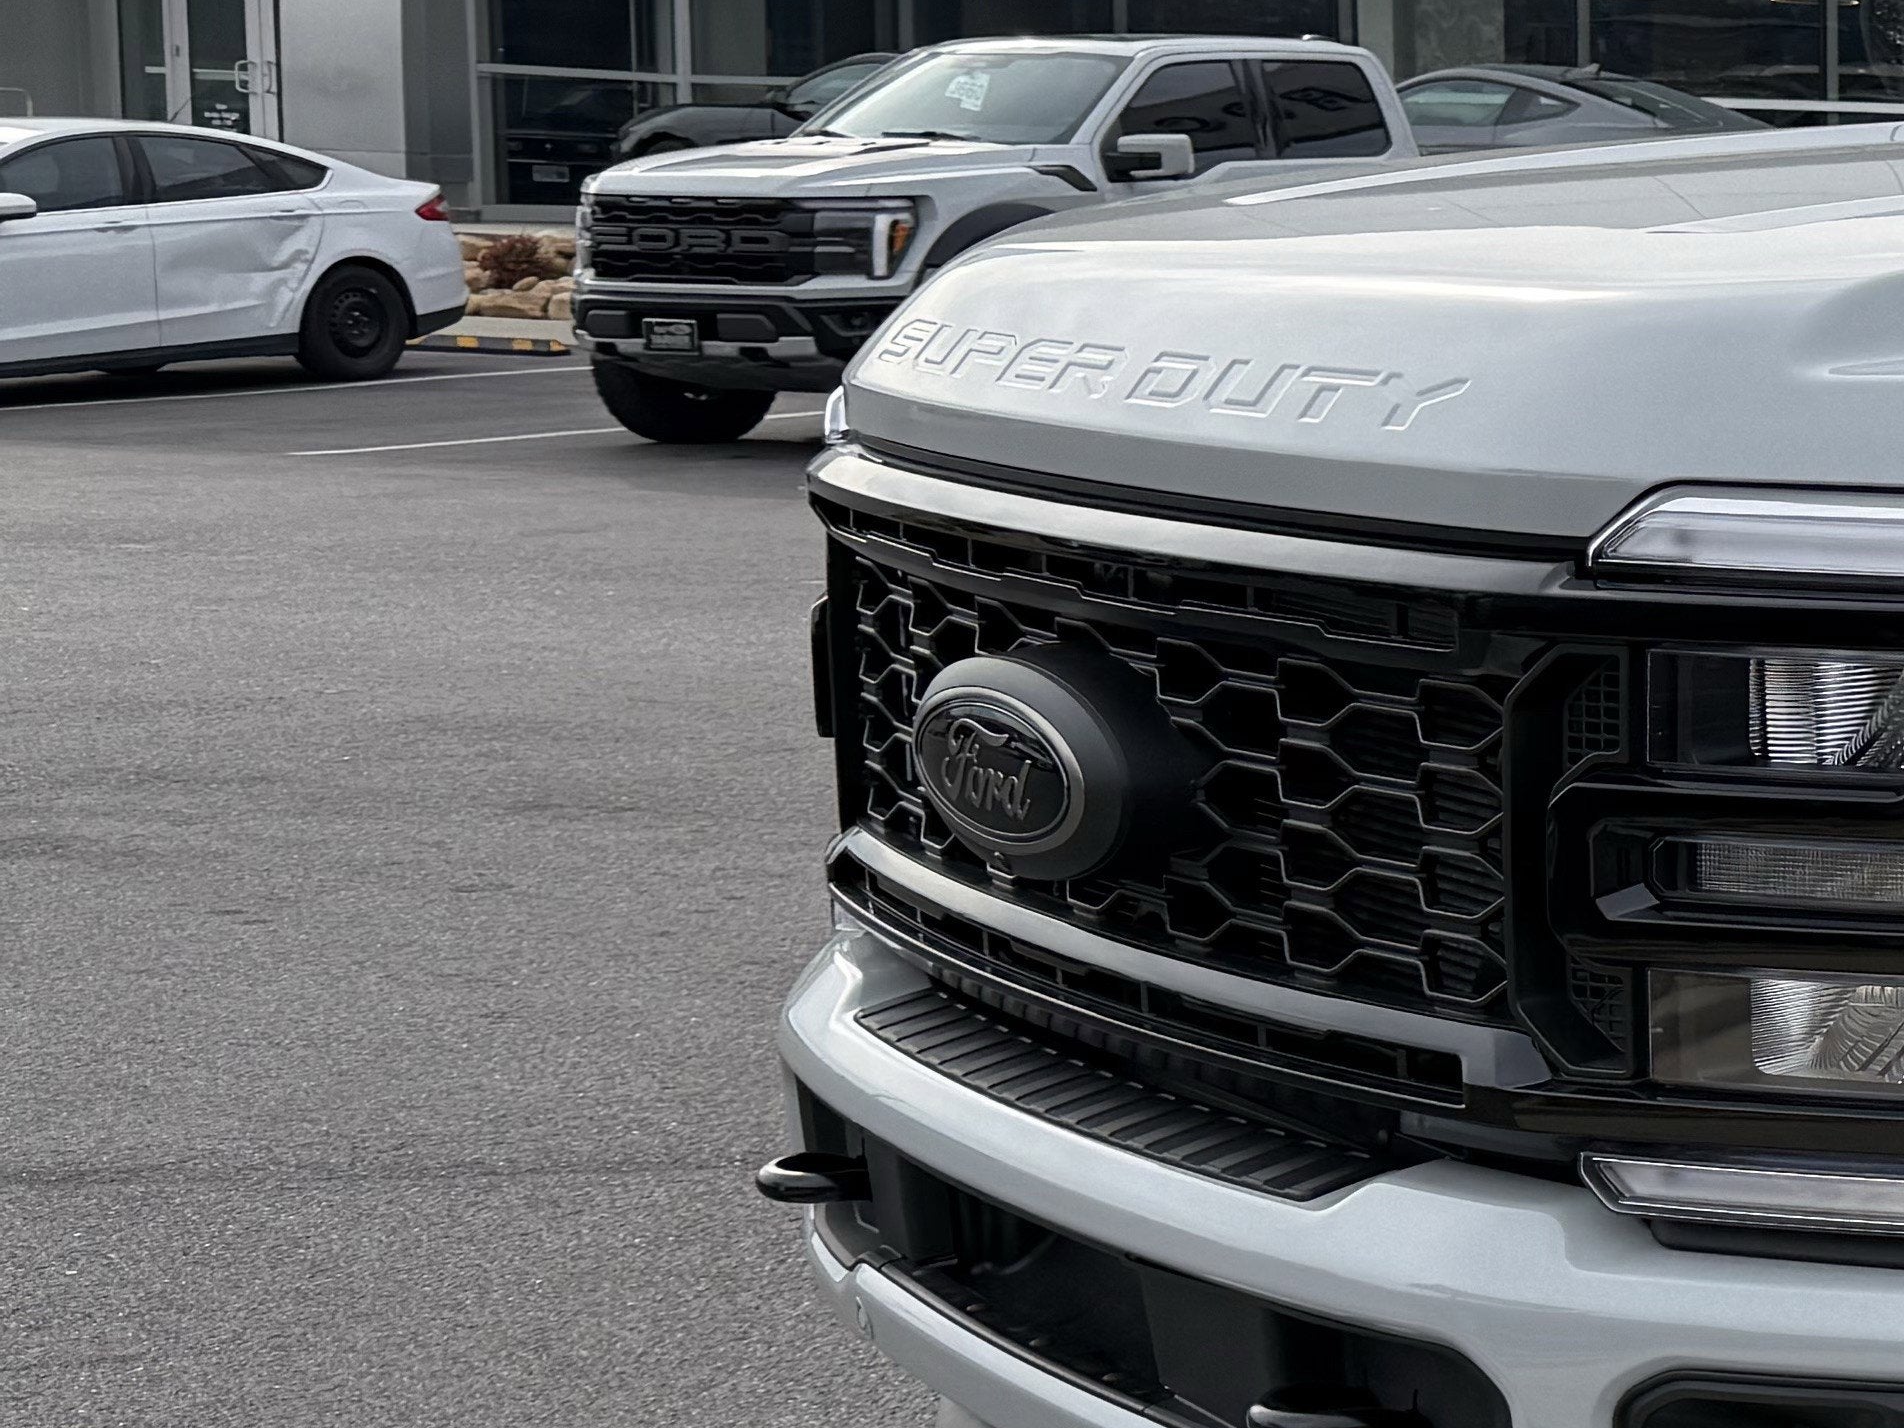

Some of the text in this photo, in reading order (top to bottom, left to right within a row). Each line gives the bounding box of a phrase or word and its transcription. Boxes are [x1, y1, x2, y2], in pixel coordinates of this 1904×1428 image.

[879, 318, 1472, 431] SUPER DUTY
[942, 717, 1033, 821] Ford
